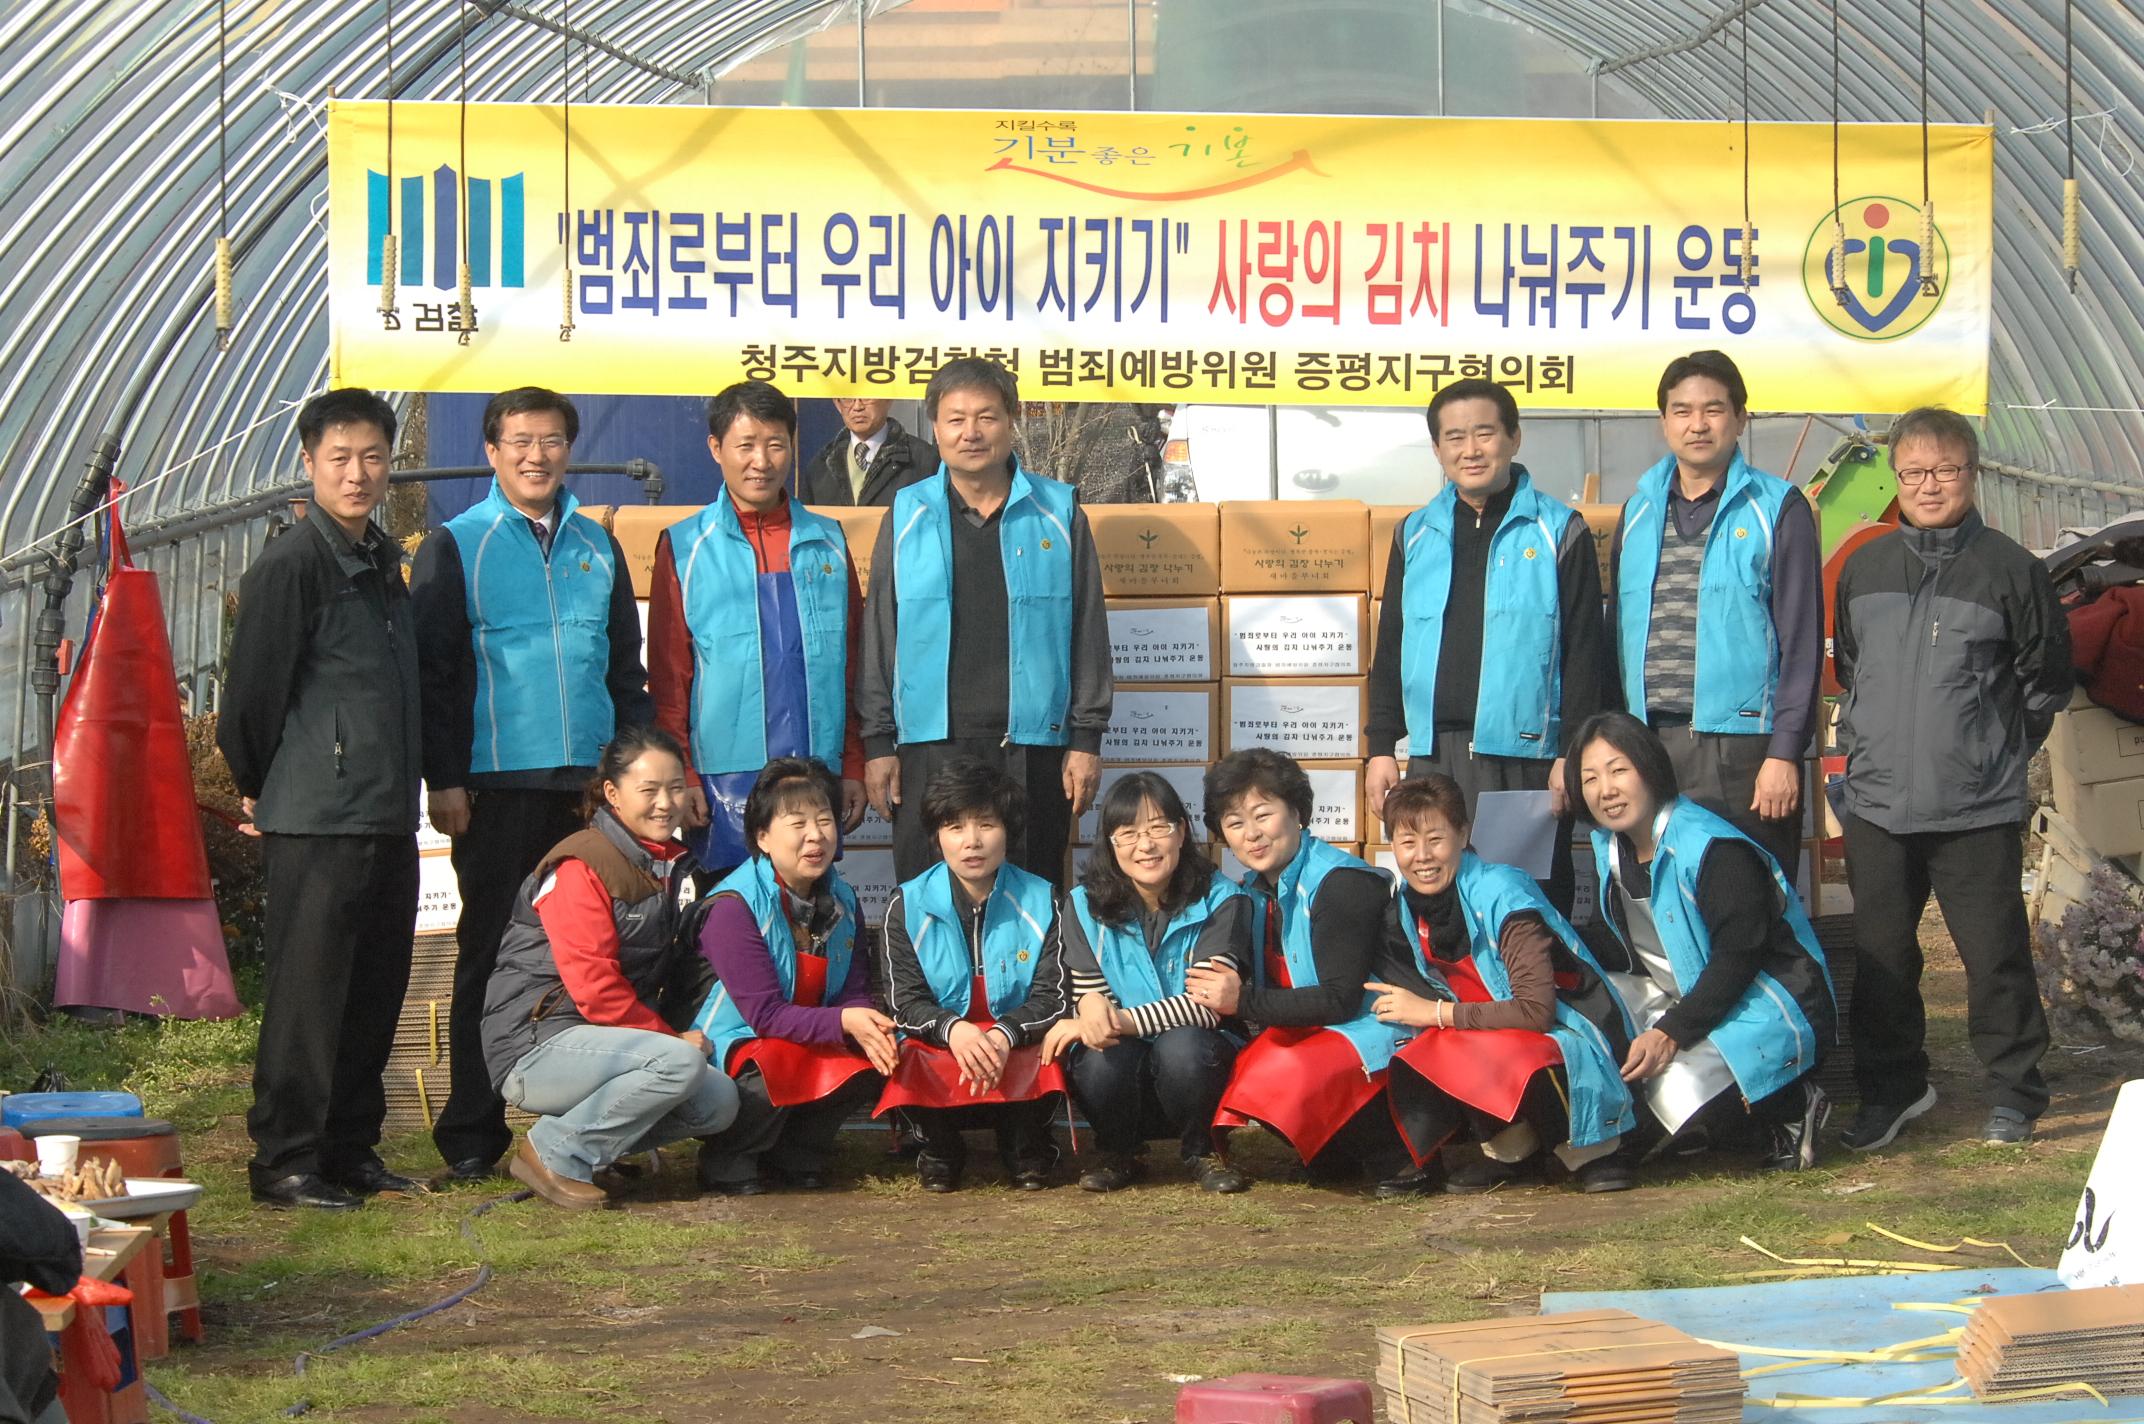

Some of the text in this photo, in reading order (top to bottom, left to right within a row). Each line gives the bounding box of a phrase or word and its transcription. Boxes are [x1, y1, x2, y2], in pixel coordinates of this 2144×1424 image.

[995, 119, 1078, 132] 지킬수록
[993, 135, 1086, 164] 기분
[1090, 146, 1157, 166] 좋은
[557, 209, 1759, 335] "범죄로부터 우리 아이 지키기" 사랑의 김치 나눠주기 운동
[1039, 347, 1278, 390] 범죄예방위원
[1293, 351, 1575, 394] 증평지구협의회
[1104, 563, 1193, 573] 사랑의 김장 나누기
[1254, 559, 1344, 569] 사랑의 김장 나누기
[1301, 631, 1316, 639] 아이
[1152, 643, 1167, 651] 아이
[1256, 643, 1279, 651] 사랑의
[1302, 643, 1333, 651] 나눠주기
[1154, 655, 1184, 663] 나눠주기
[1282, 721, 1297, 729] 우리
[1151, 727, 1167, 735] 아이
[1303, 733, 1333, 741] 나눠주기
[1105, 738, 1128, 746] 사랑의
[1152, 739, 1183, 747] 나눠주기
